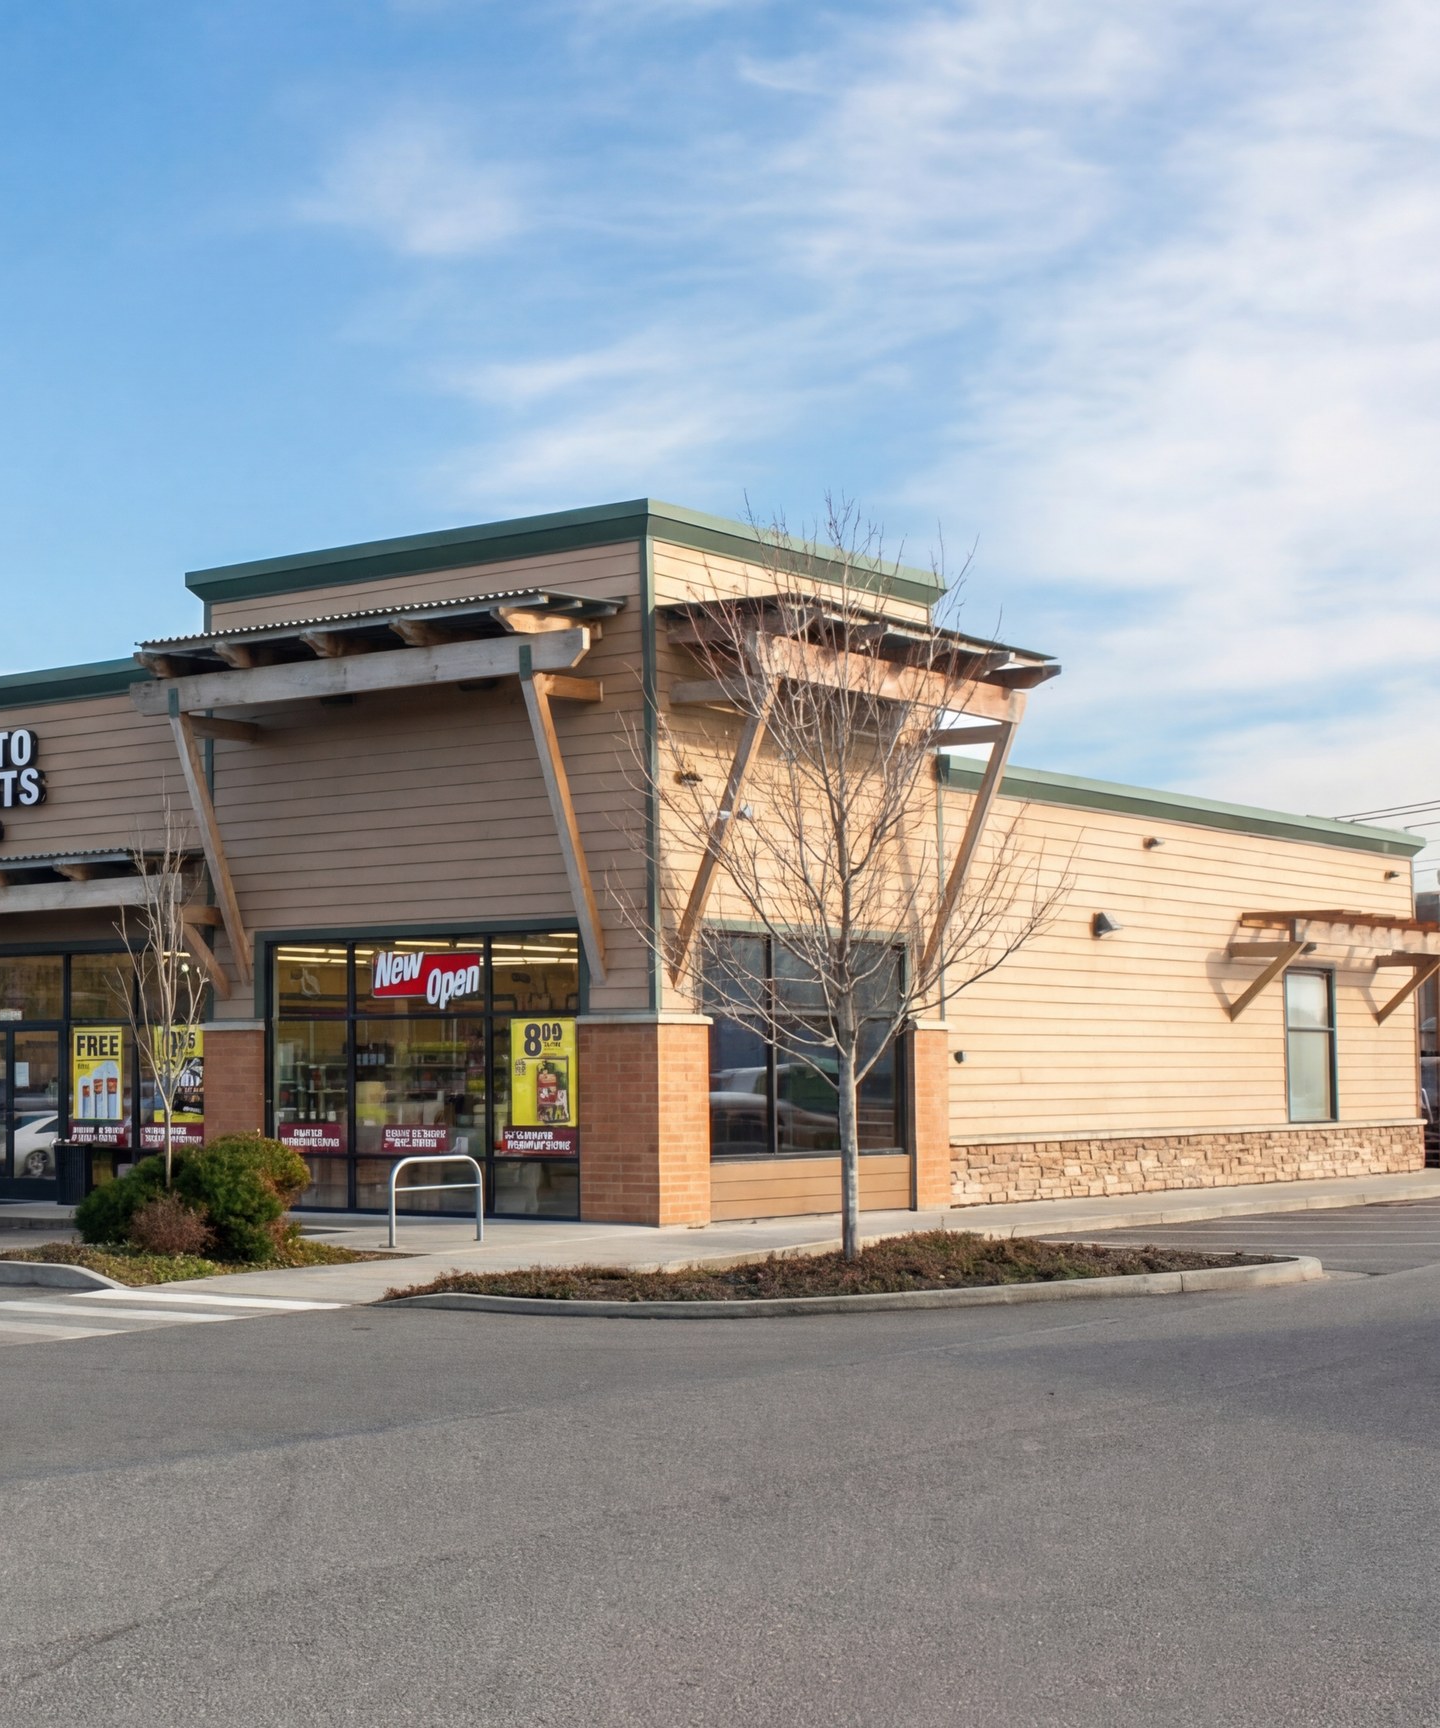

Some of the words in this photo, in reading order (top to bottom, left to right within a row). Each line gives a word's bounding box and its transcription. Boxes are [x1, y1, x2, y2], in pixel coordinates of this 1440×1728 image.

[374, 951, 424, 989] New
[426, 965, 480, 1010] Open
[76, 1035, 119, 1057] FREE
